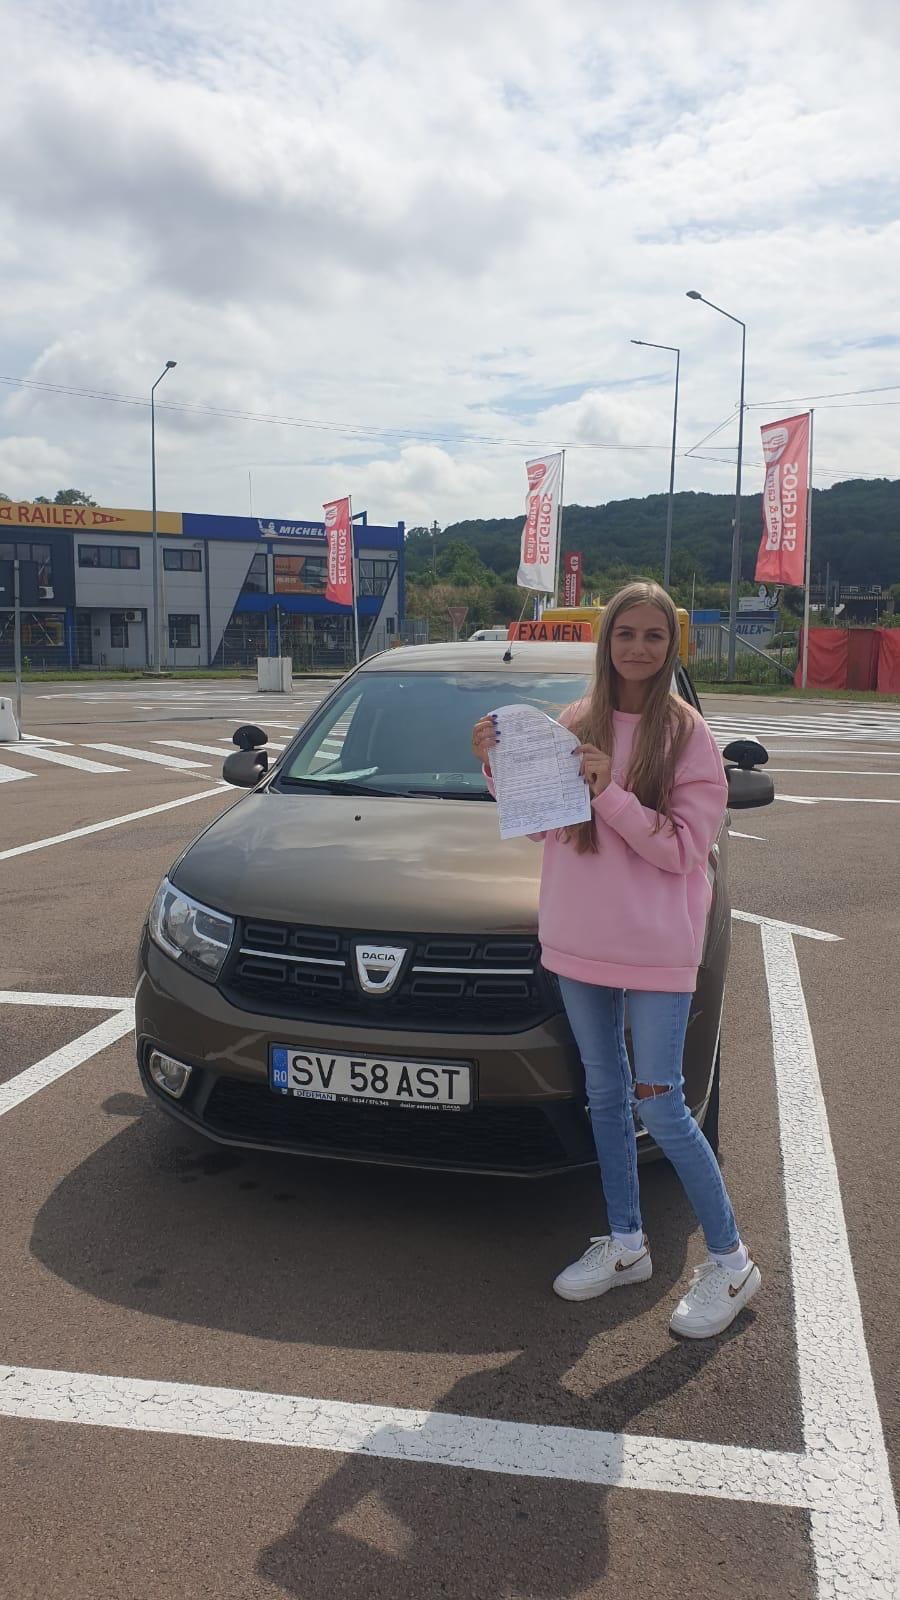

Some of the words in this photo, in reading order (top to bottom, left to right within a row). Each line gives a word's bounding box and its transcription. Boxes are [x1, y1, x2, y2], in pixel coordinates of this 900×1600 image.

[18, 506, 86, 525] RAILEX
[736, 624, 762, 635] AILEX
[362, 952, 396, 961] DACIA
[273, 1070, 287, 1082] RO
[292, 1055, 336, 1088] SV
[350, 1061, 389, 1093] 58
[396, 1066, 460, 1099] AST
